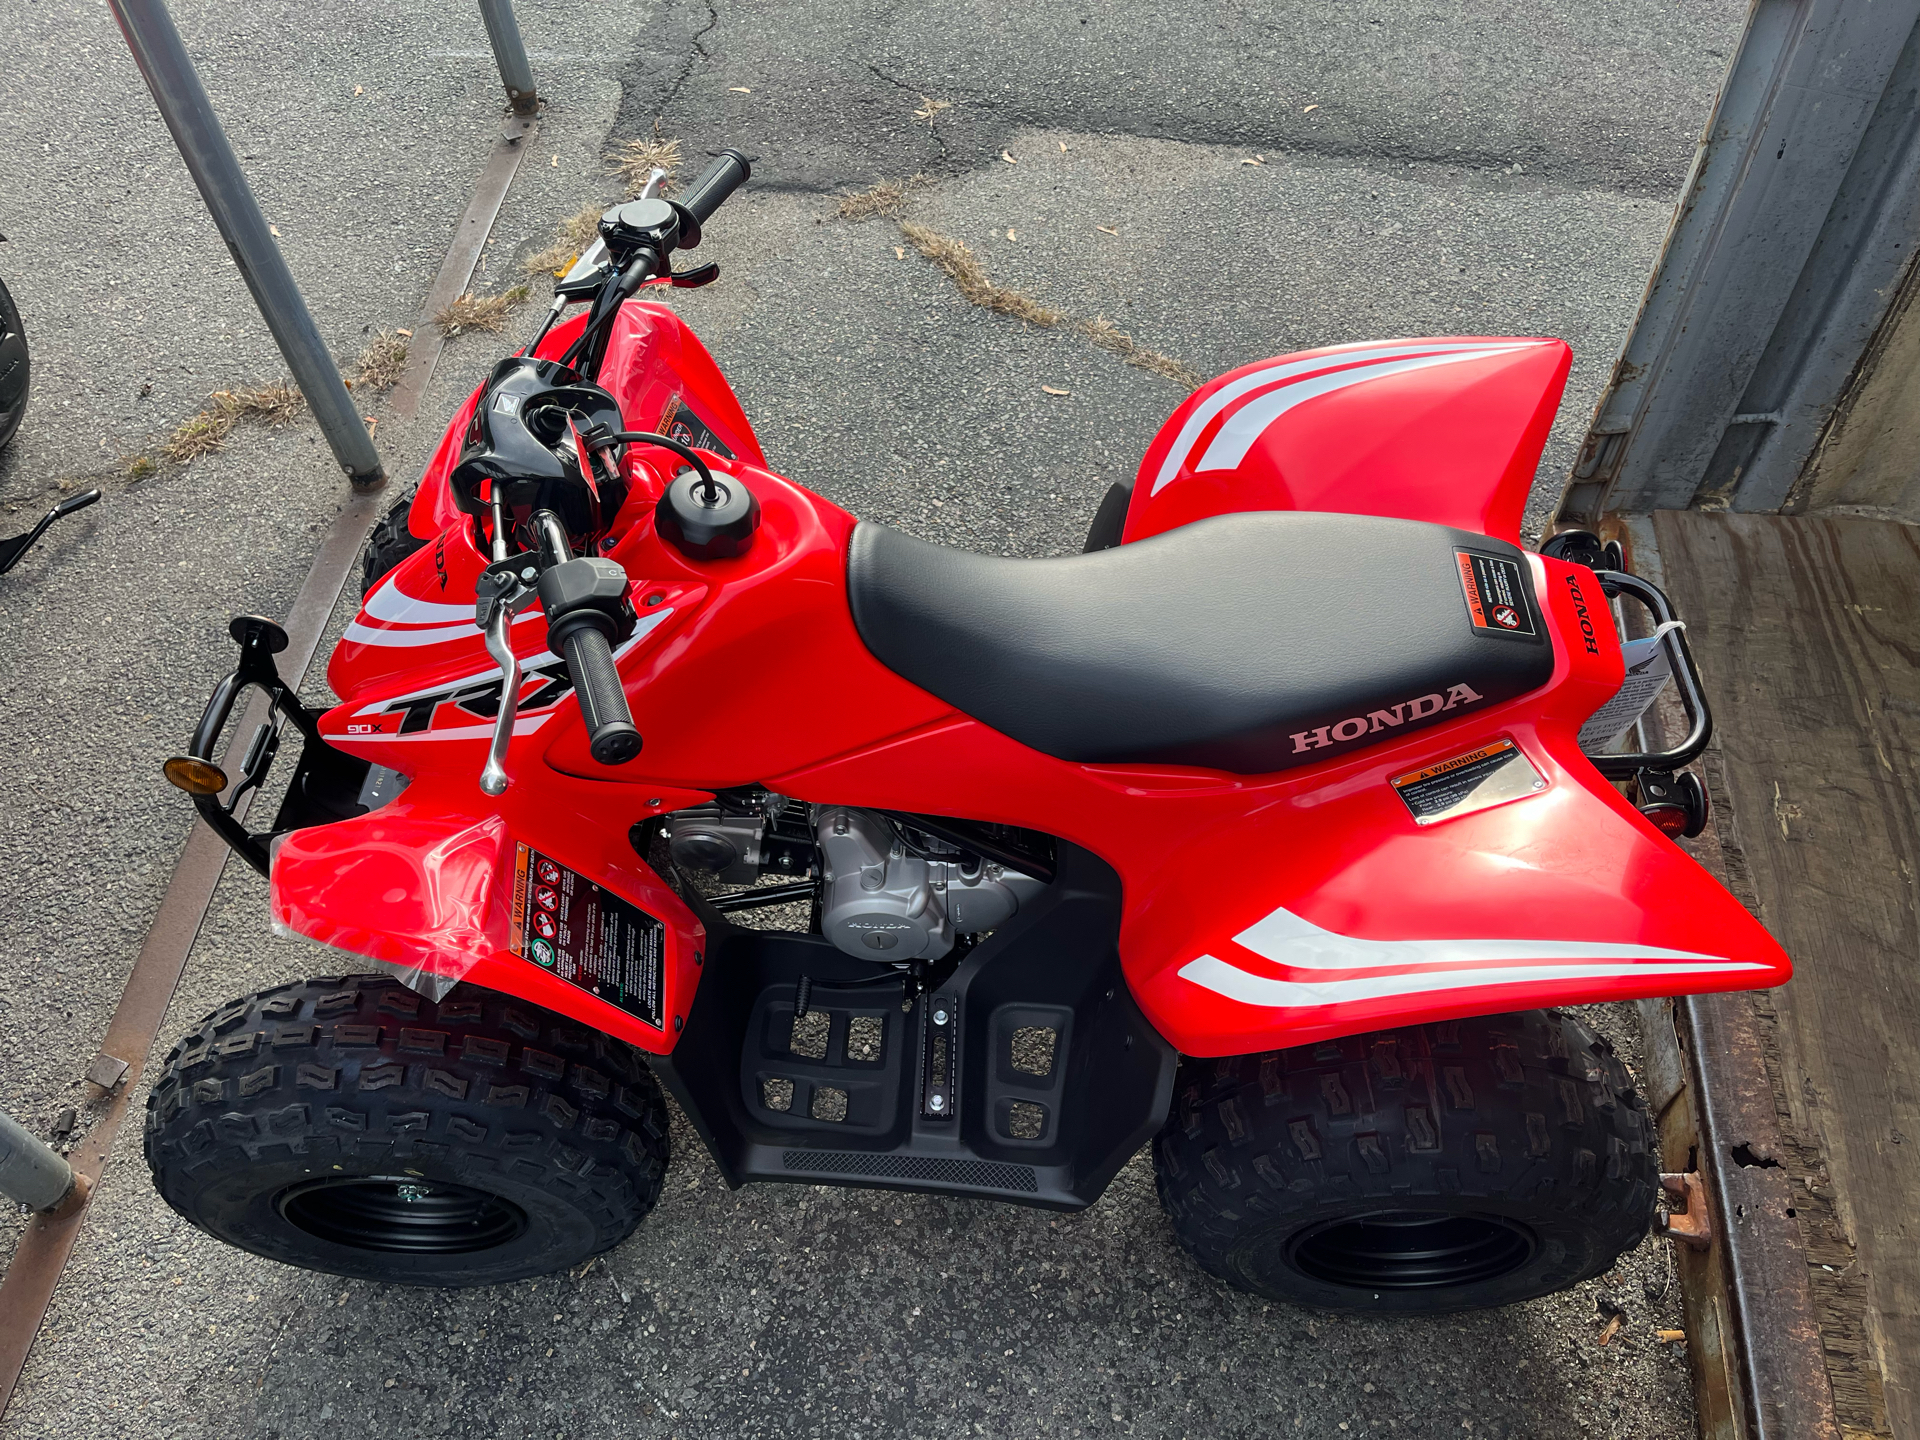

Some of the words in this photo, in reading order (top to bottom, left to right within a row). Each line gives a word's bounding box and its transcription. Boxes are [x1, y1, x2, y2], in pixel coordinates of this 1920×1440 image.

[659, 402, 678, 435] WARNING
[681, 434, 690, 445] 10
[1462, 563, 1479, 604] WARNING
[1565, 574, 1599, 656] HONDA
[1289, 683, 1483, 754] HONDA
[1430, 749, 1487, 774] WARNING
[515, 868, 524, 918] WARNING
[847, 921, 911, 930] HONDA
